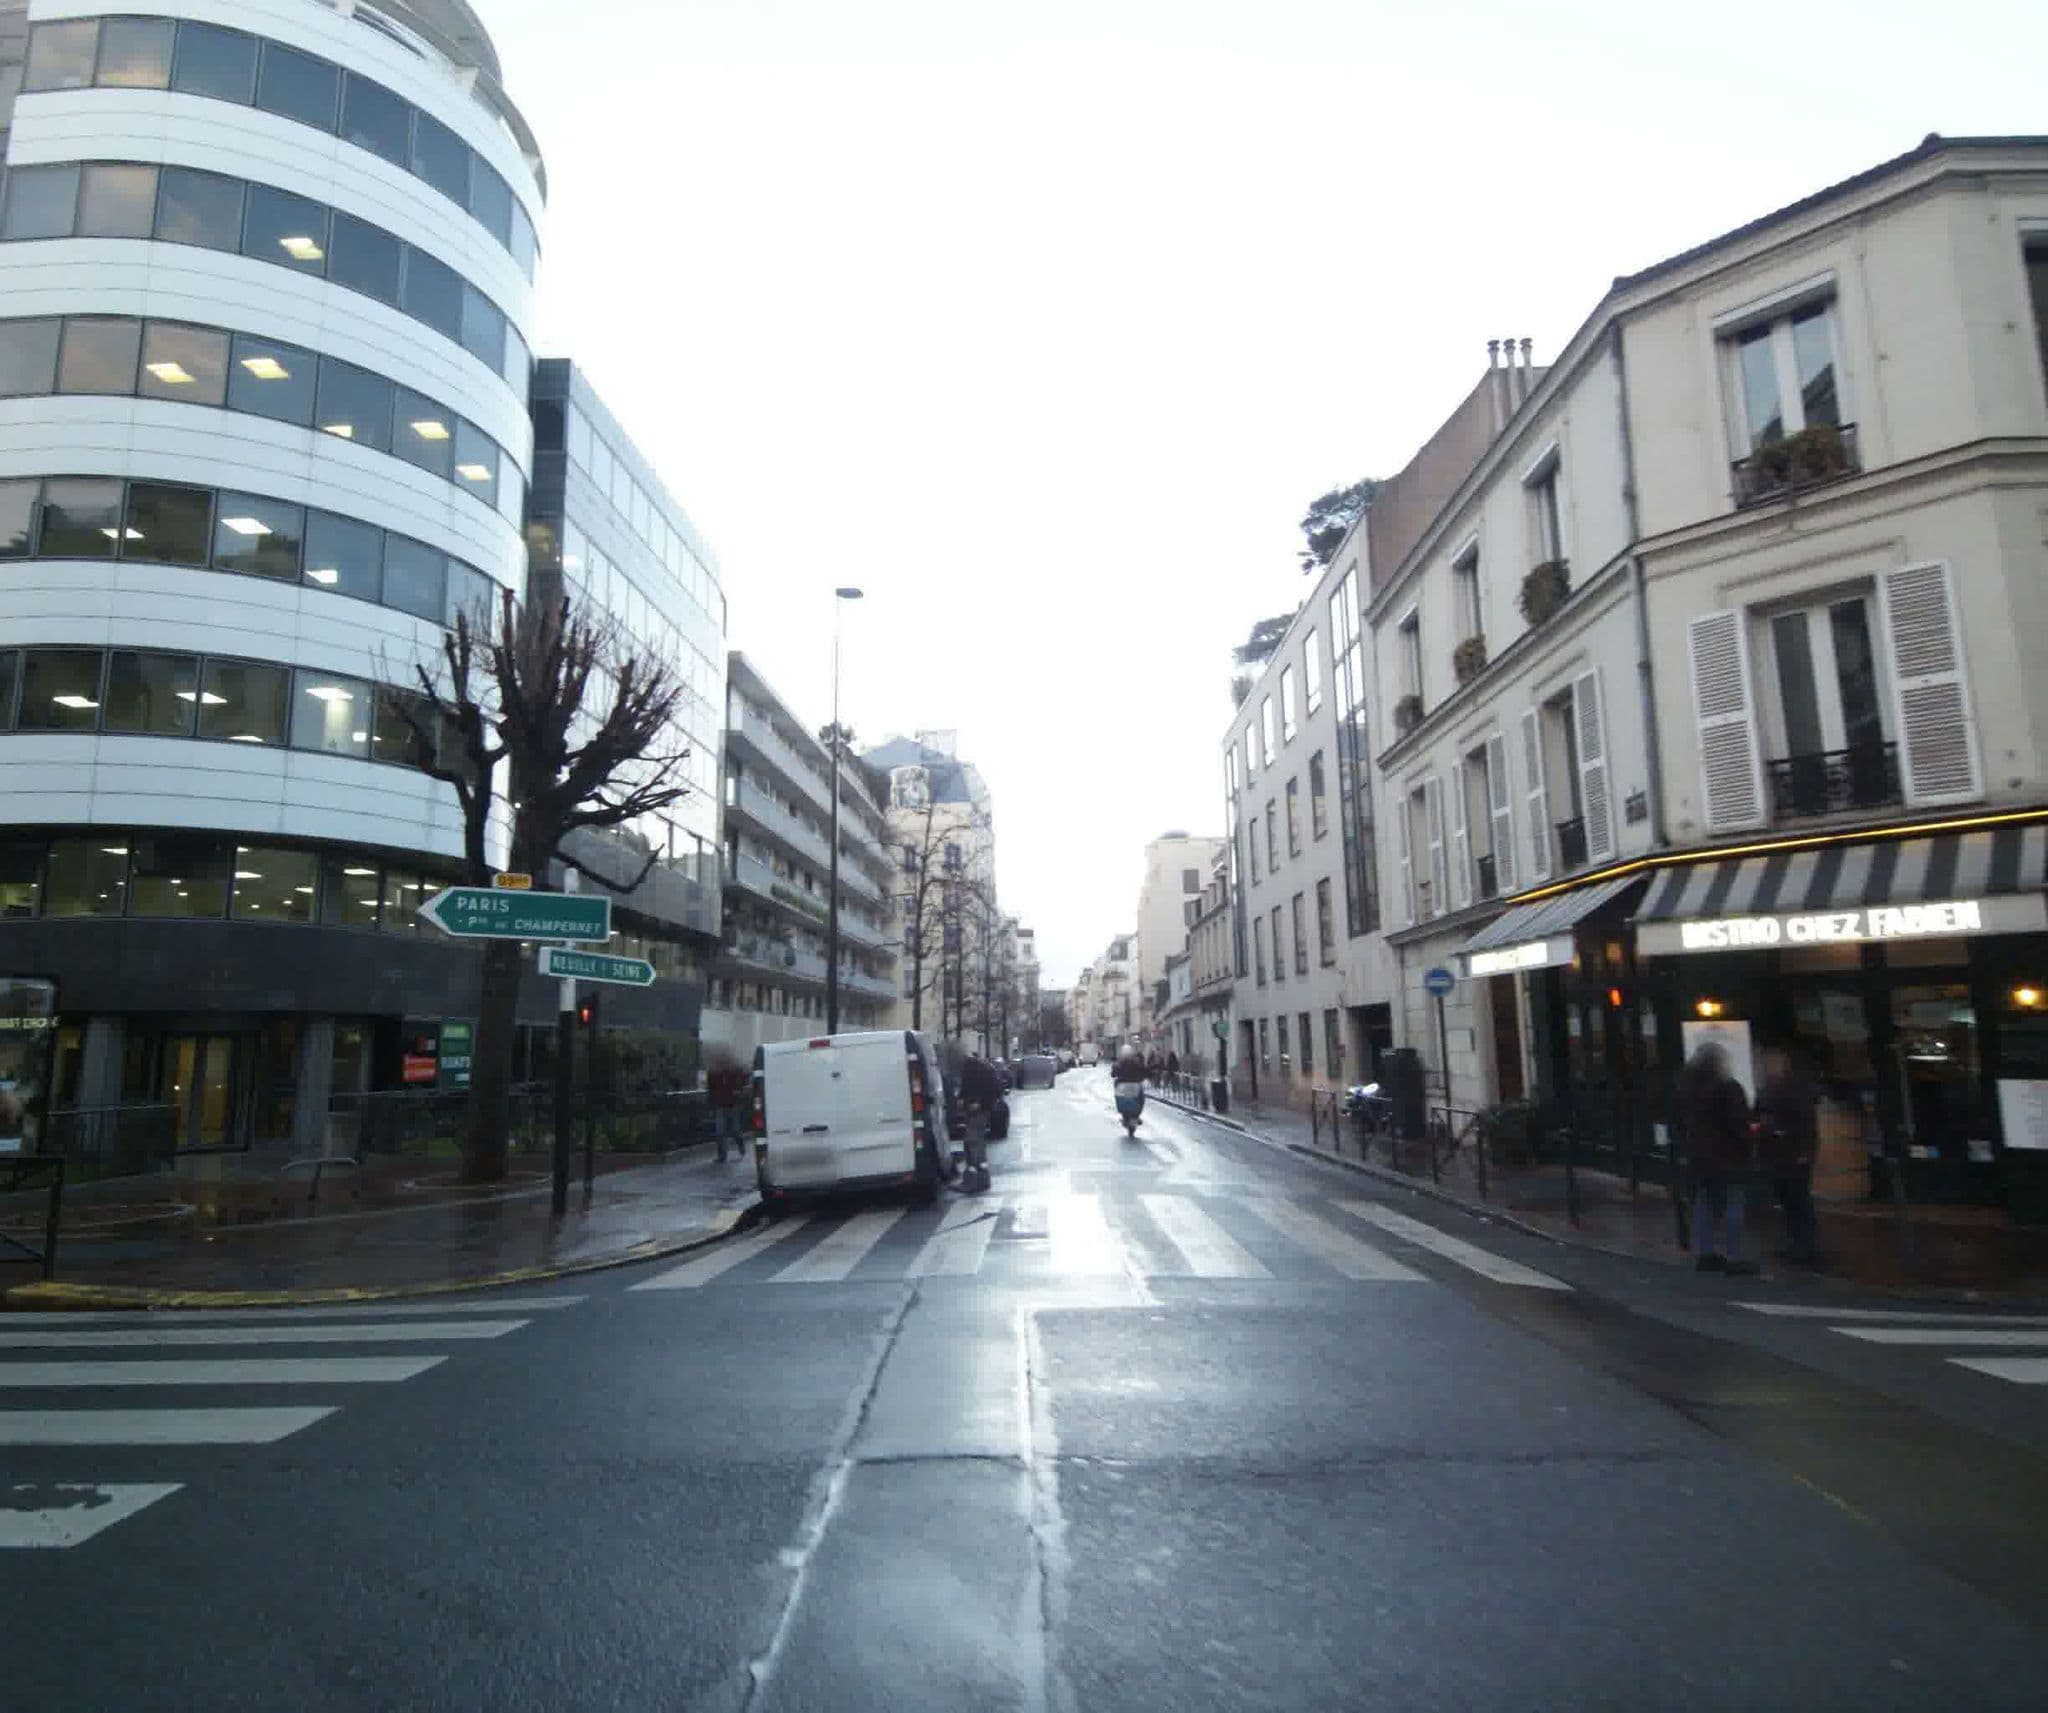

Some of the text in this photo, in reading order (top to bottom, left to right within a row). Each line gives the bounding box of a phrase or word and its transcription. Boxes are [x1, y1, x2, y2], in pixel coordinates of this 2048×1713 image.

[457, 896, 509, 912] PARIS
[1682, 902, 1981, 947] BISTRO CHEZ FABIEN
